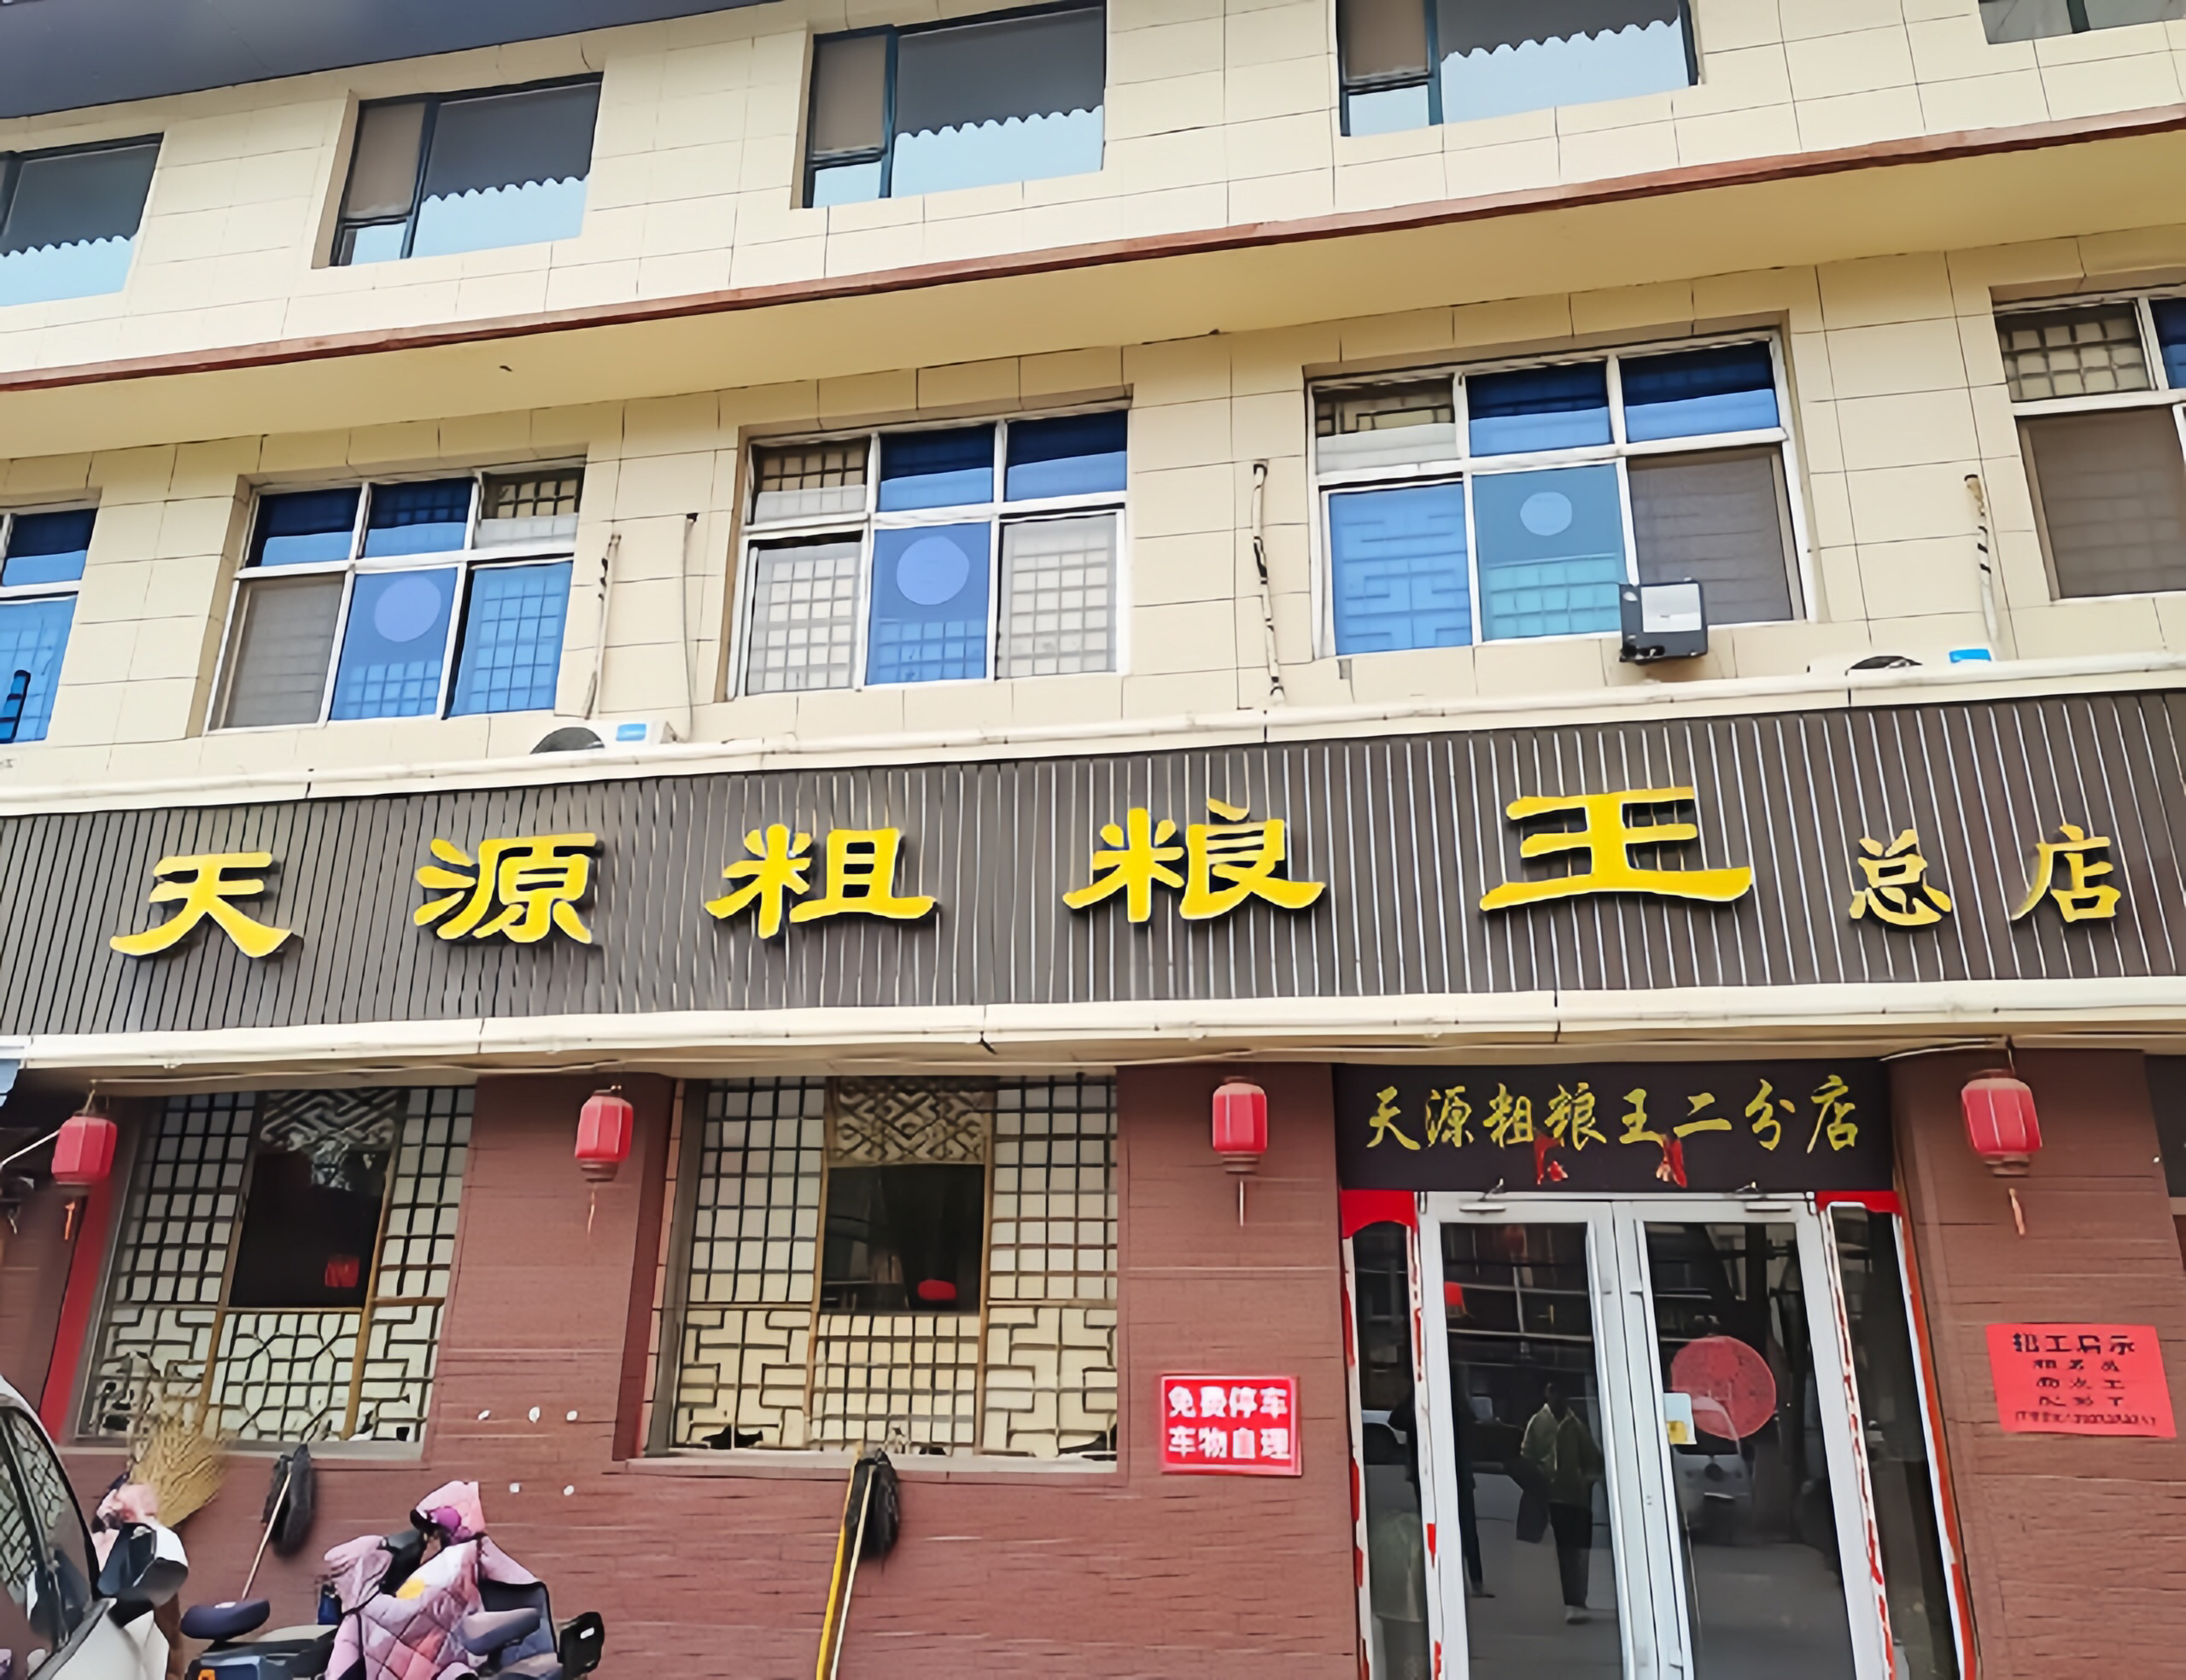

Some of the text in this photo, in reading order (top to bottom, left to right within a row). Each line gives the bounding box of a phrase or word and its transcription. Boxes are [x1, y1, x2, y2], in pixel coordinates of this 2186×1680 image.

[1366, 1074, 1859, 1154] 天源粗粮王二分店
[1167, 1385, 1289, 1420] 免费停车
[1167, 1425, 1291, 1460] 车物自理
